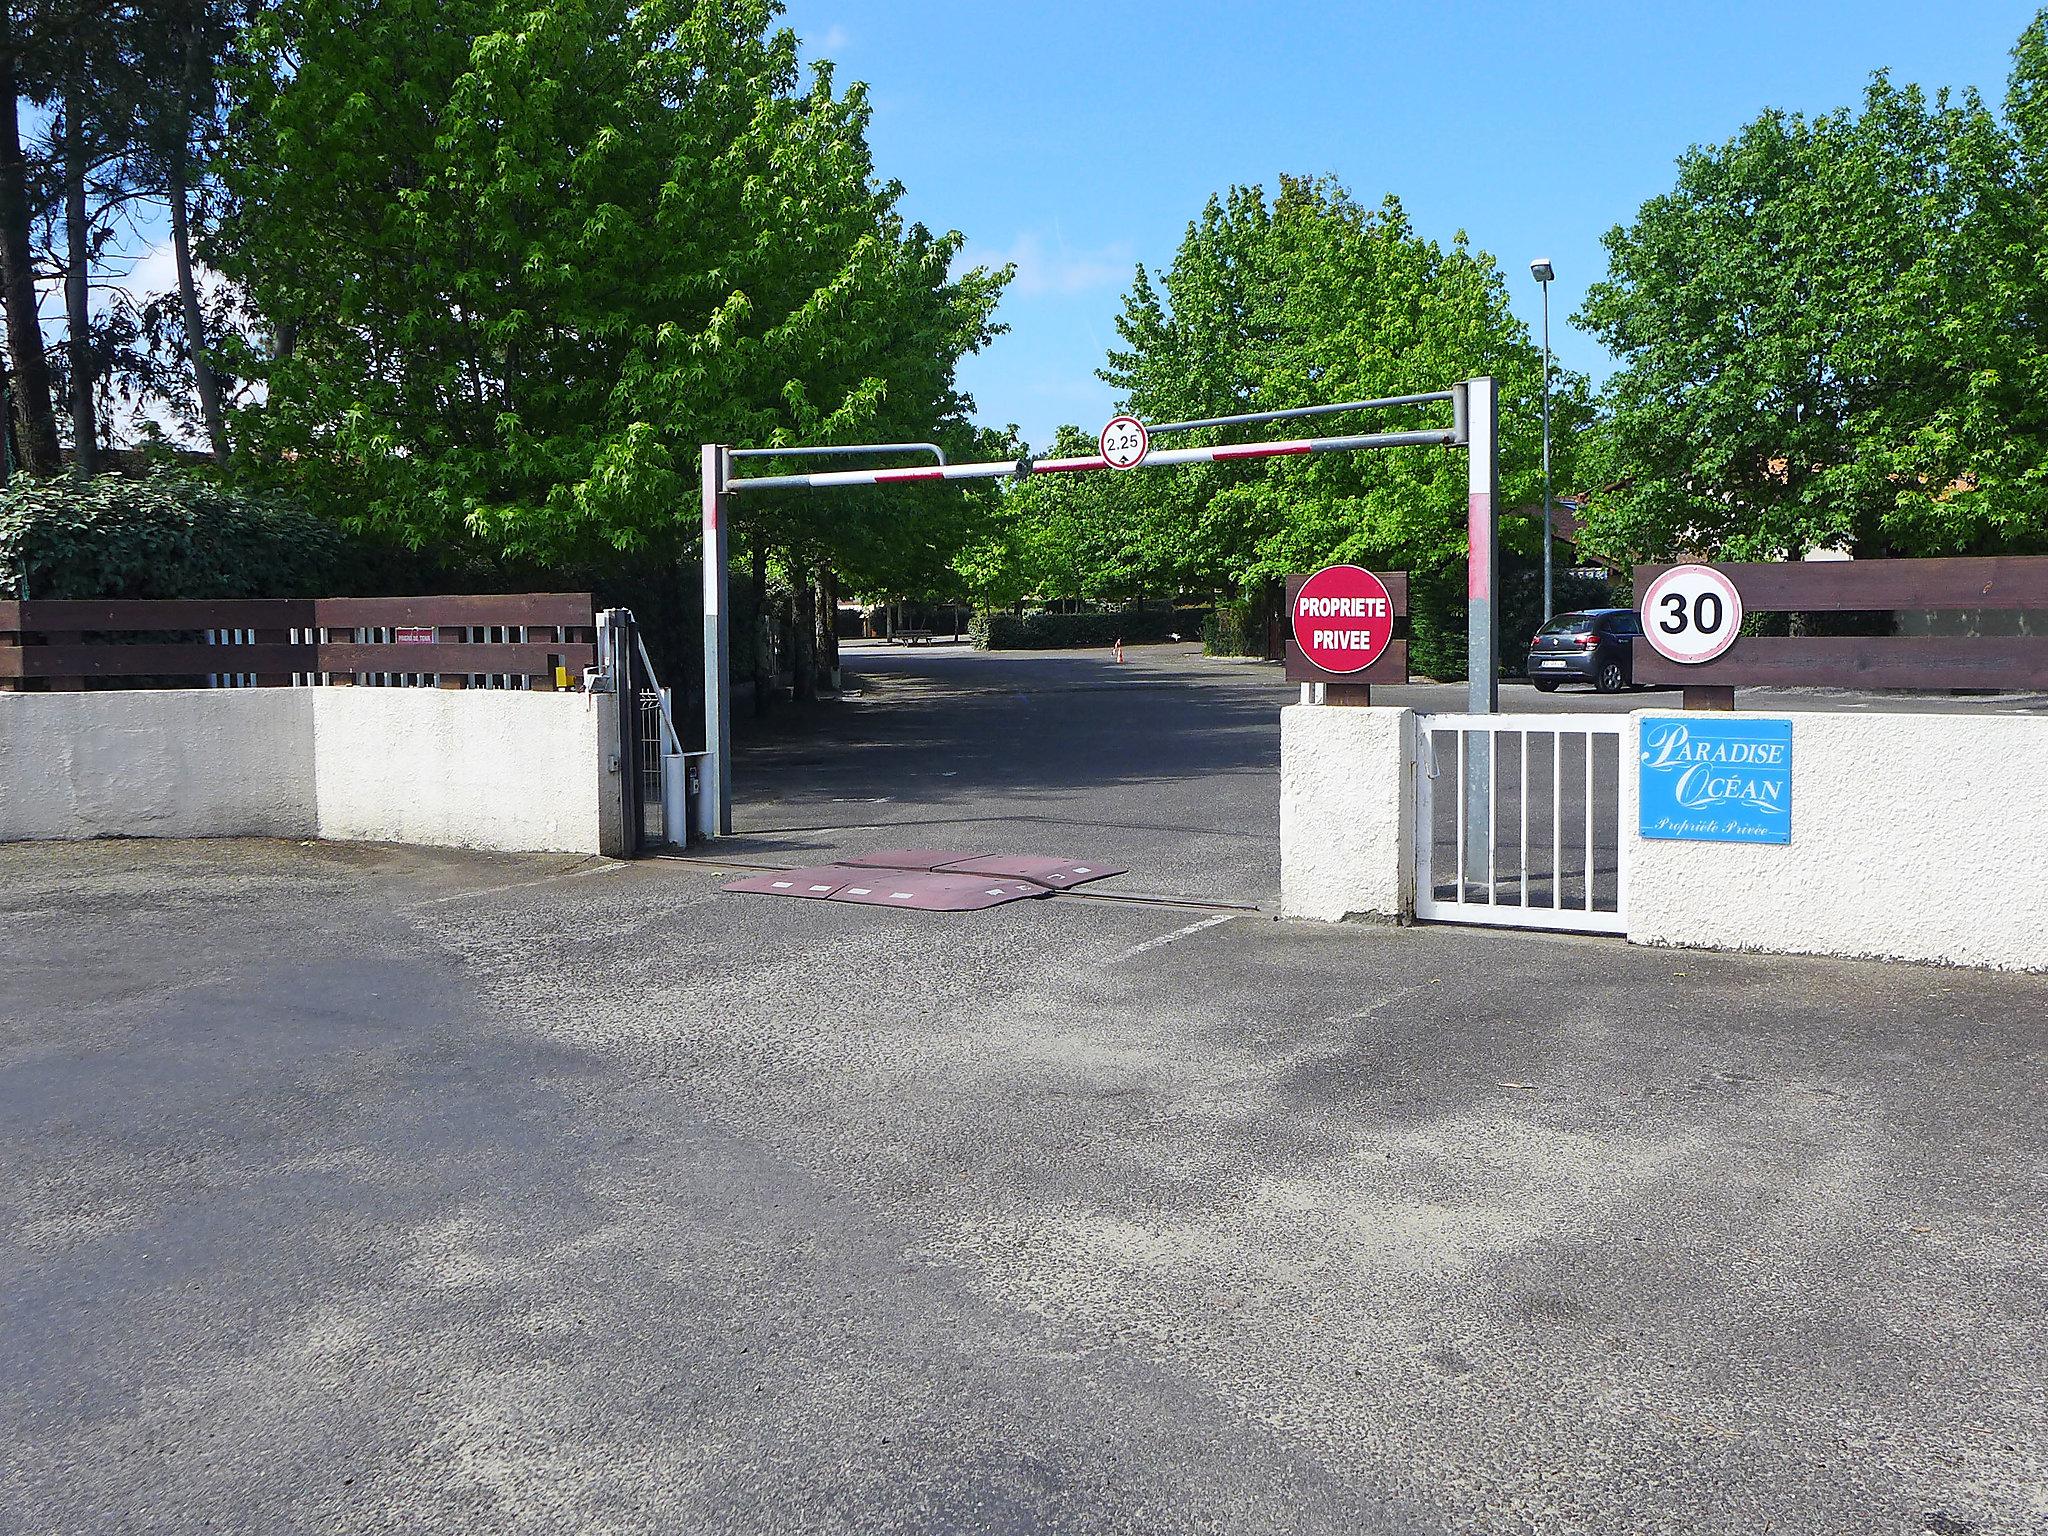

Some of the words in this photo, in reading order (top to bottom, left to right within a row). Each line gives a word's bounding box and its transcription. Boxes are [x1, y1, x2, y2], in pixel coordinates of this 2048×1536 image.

[1107, 434, 1138, 451] 2.25
[1299, 597, 1386, 617] PROPRIETE
[1659, 592, 1723, 635] 30
[1313, 630, 1370, 650] PRIVEE
[1654, 816, 1718, 836] Propriété
[1721, 819, 1768, 836] Privée
